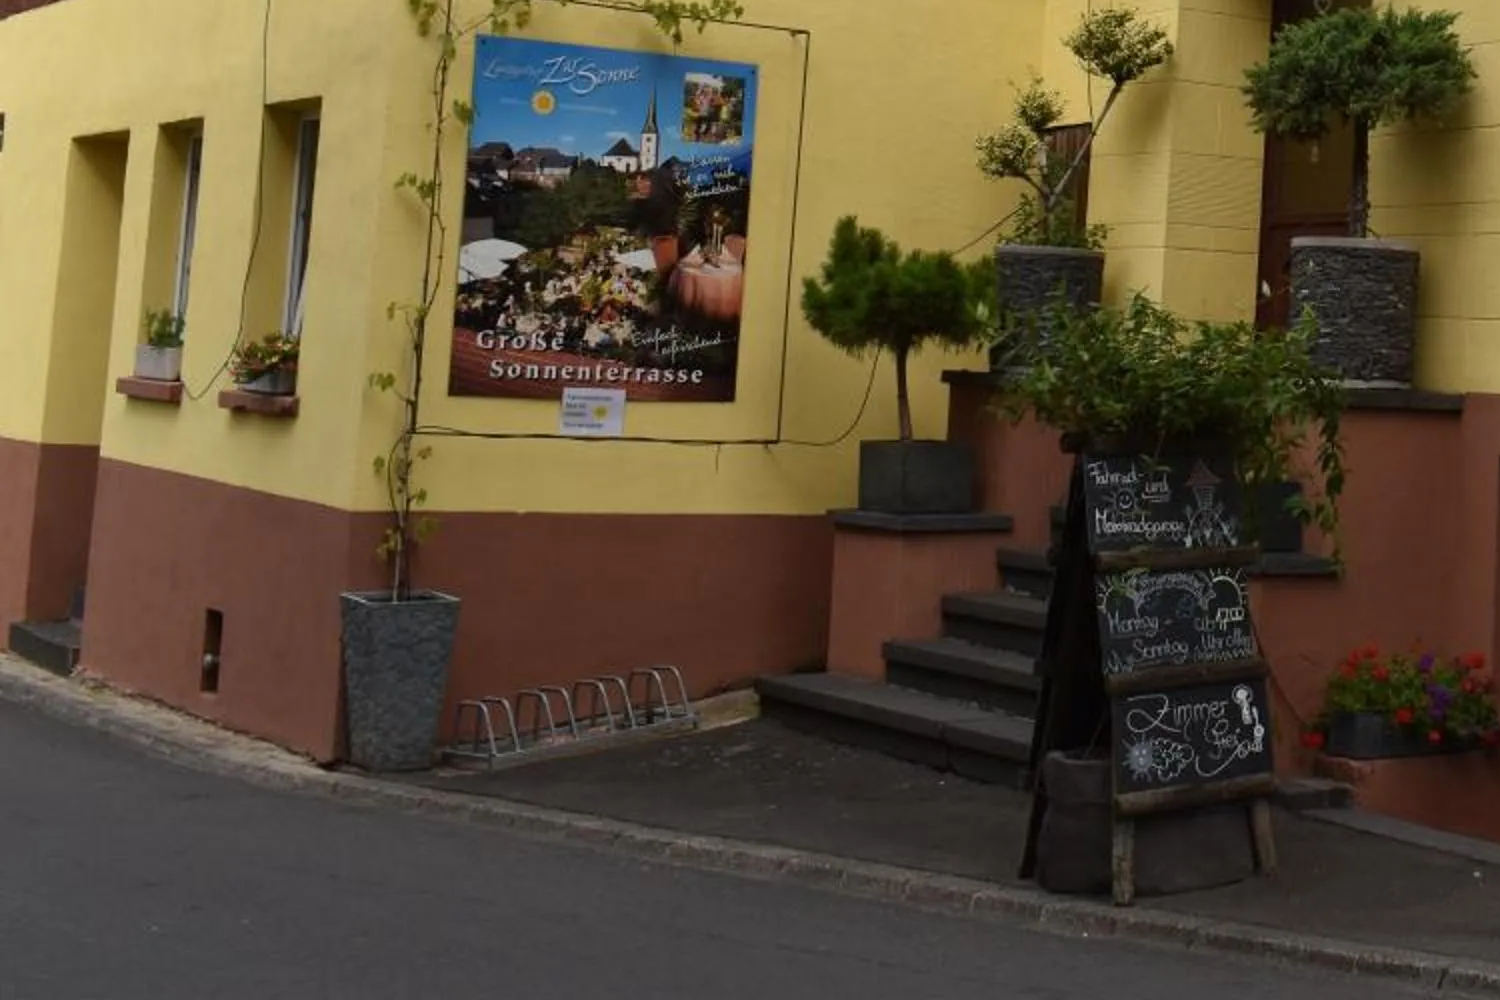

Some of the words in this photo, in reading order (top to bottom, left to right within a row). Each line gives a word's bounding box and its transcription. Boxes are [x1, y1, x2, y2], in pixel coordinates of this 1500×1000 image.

[569, 60, 640, 95] Sonne
[476, 328, 565, 352] Große
[489, 358, 705, 385] Sonnenterrasse
[1126, 692, 1229, 734] Zimmer
